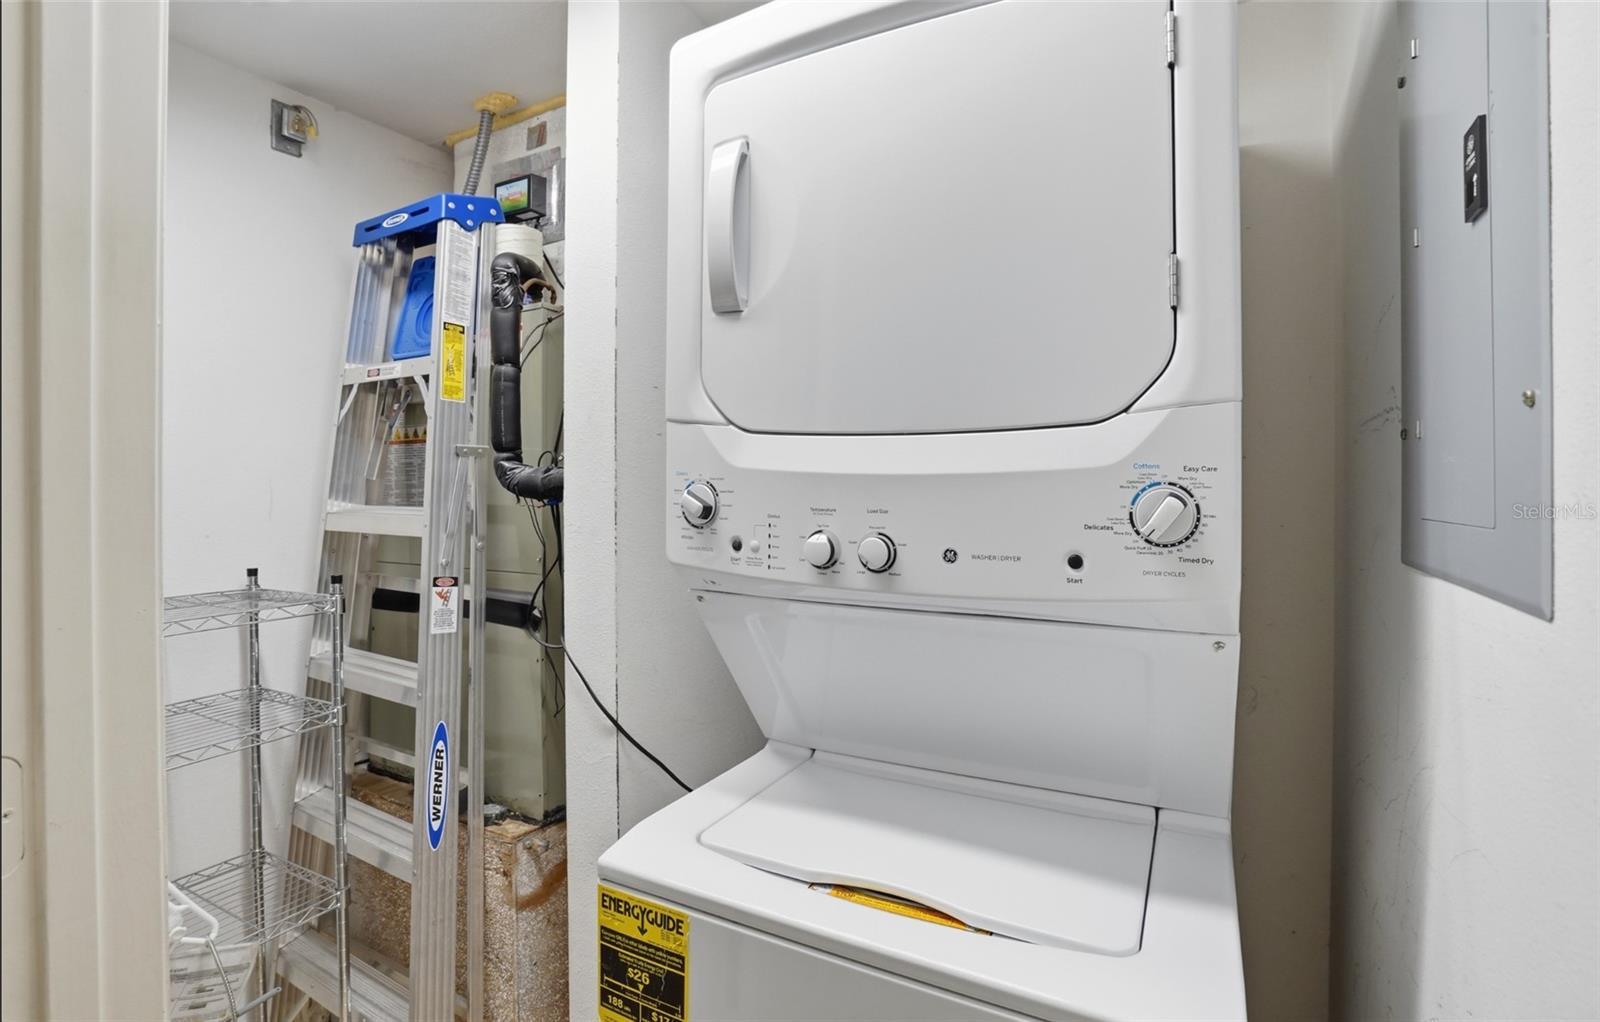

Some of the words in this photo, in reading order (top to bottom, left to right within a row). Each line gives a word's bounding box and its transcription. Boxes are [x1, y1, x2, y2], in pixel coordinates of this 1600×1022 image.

[432, 748, 444, 822] WERNER
[602, 893, 684, 936] ENERGYGUIDE
[627, 968, 650, 985] $26
[608, 995, 623, 1008] 188
